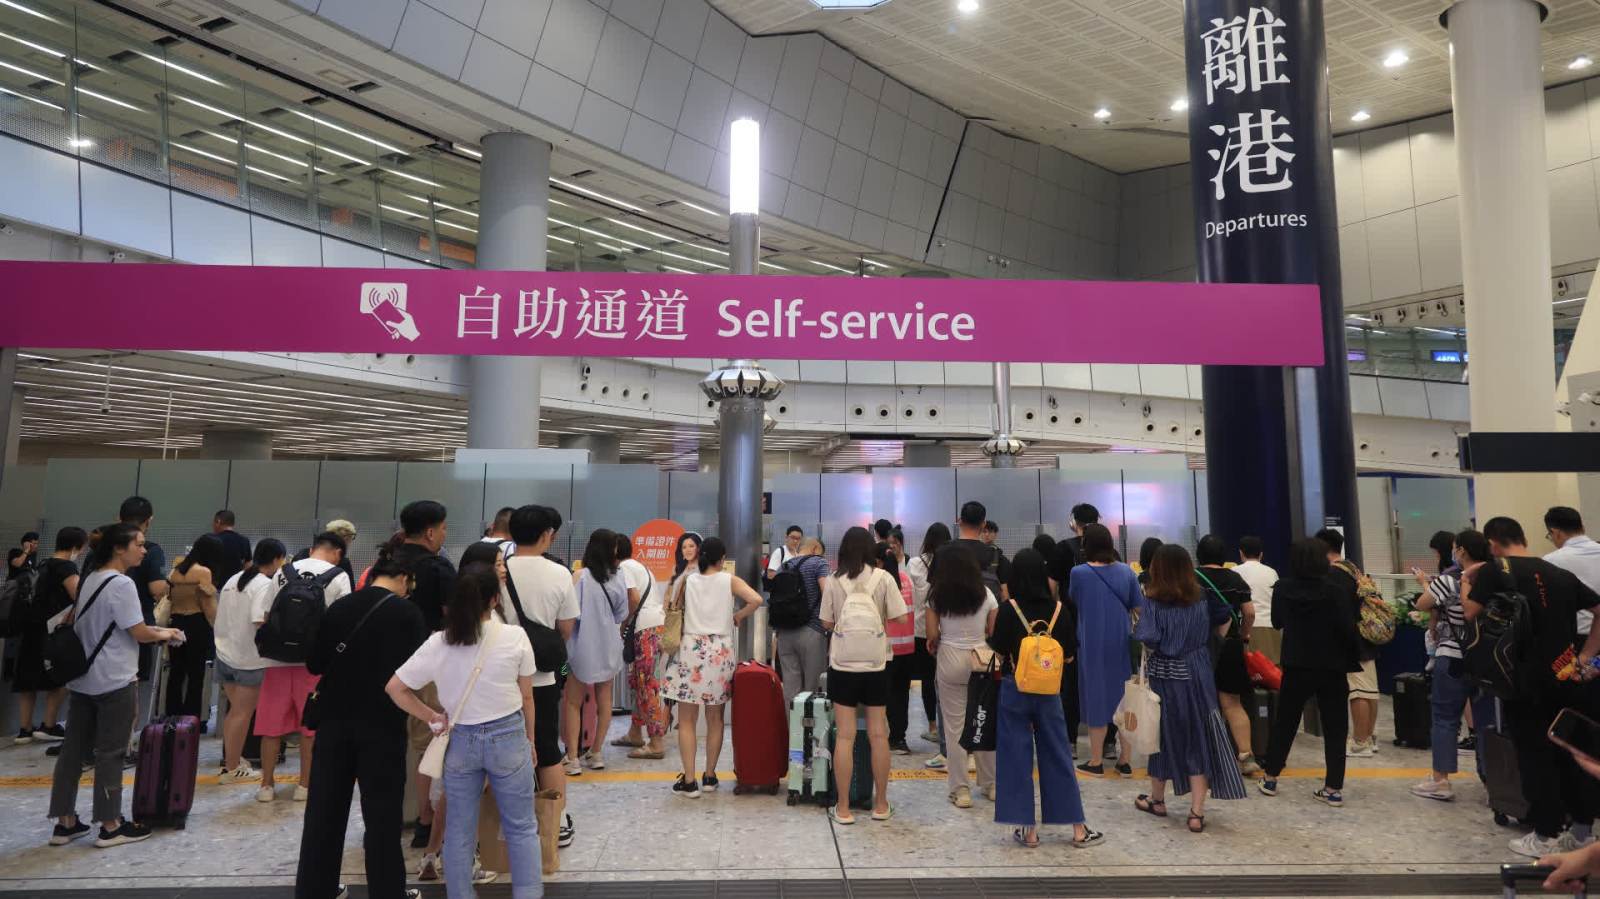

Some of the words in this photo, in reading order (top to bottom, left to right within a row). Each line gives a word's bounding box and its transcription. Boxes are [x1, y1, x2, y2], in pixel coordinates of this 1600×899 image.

[1200, 7, 1295, 200] 離港
[1205, 212, 1308, 239] Departures
[457, 285, 689, 341] 自助通道
[718, 298, 975, 341] Self-service
